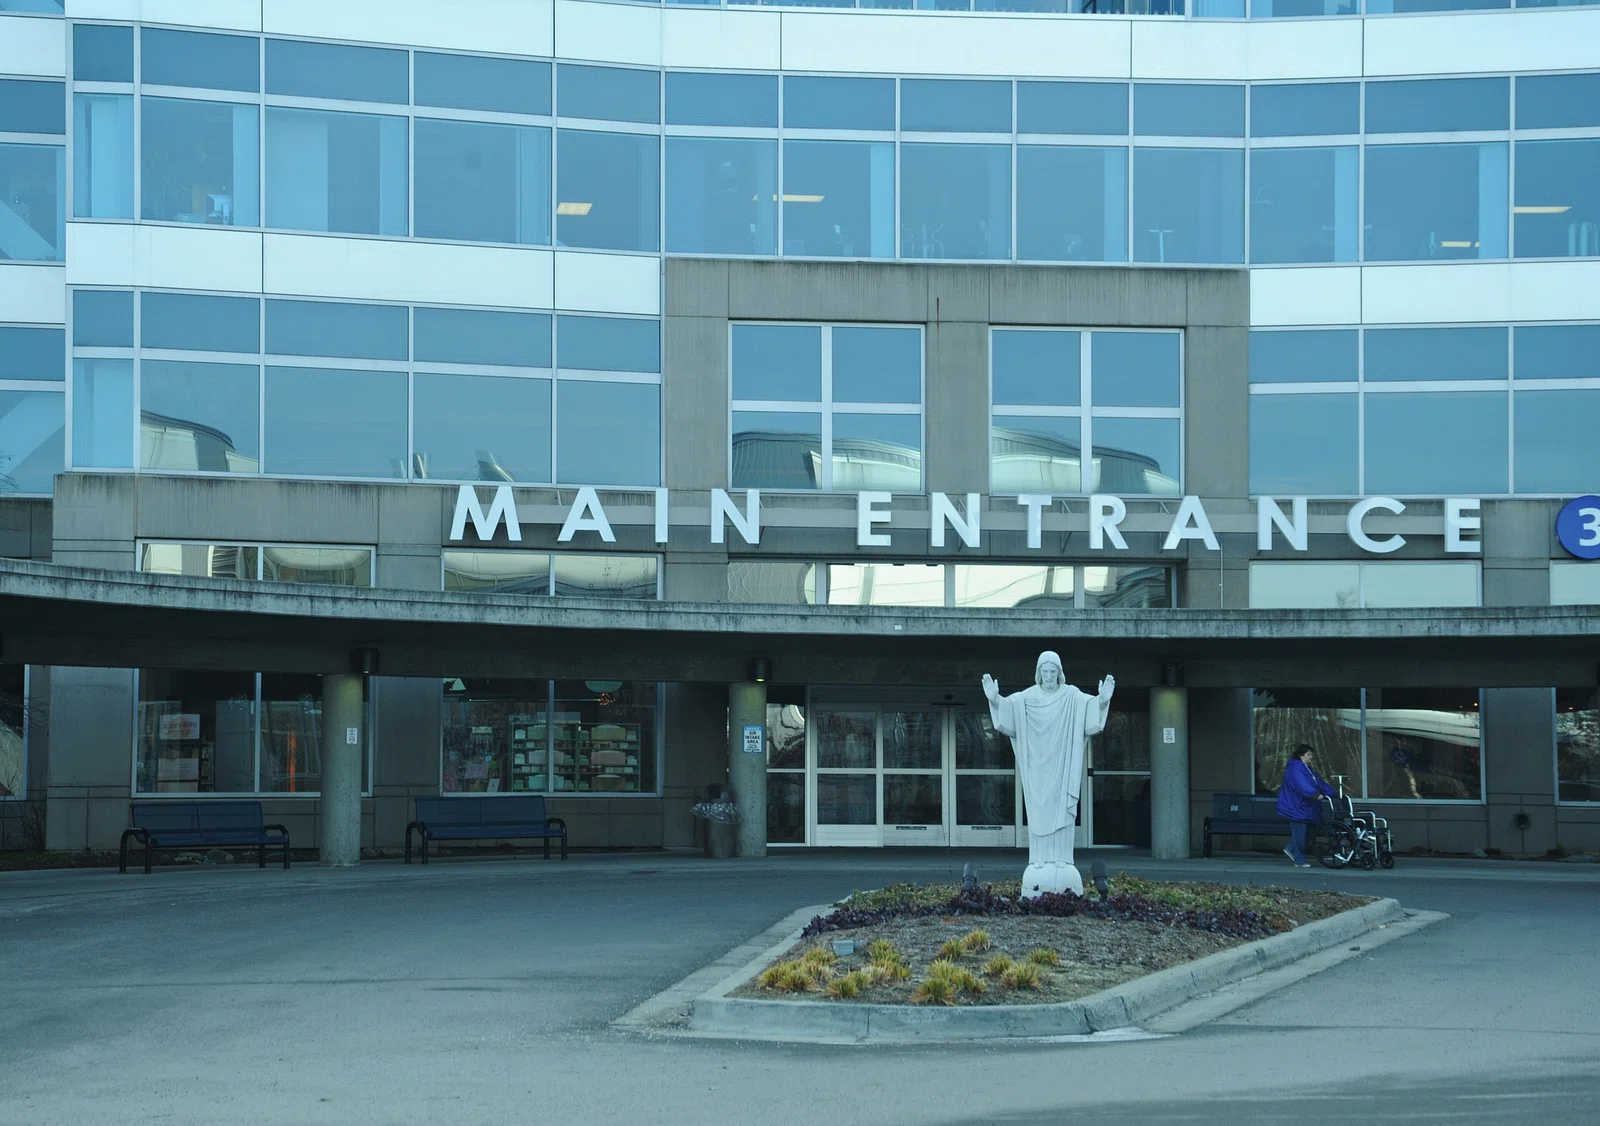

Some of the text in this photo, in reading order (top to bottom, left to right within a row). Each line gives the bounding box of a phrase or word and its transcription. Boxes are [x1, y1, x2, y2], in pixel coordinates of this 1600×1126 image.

[450, 485, 1482, 553] MAIN ENTRANCE
[1578, 507, 1600, 547] 3
